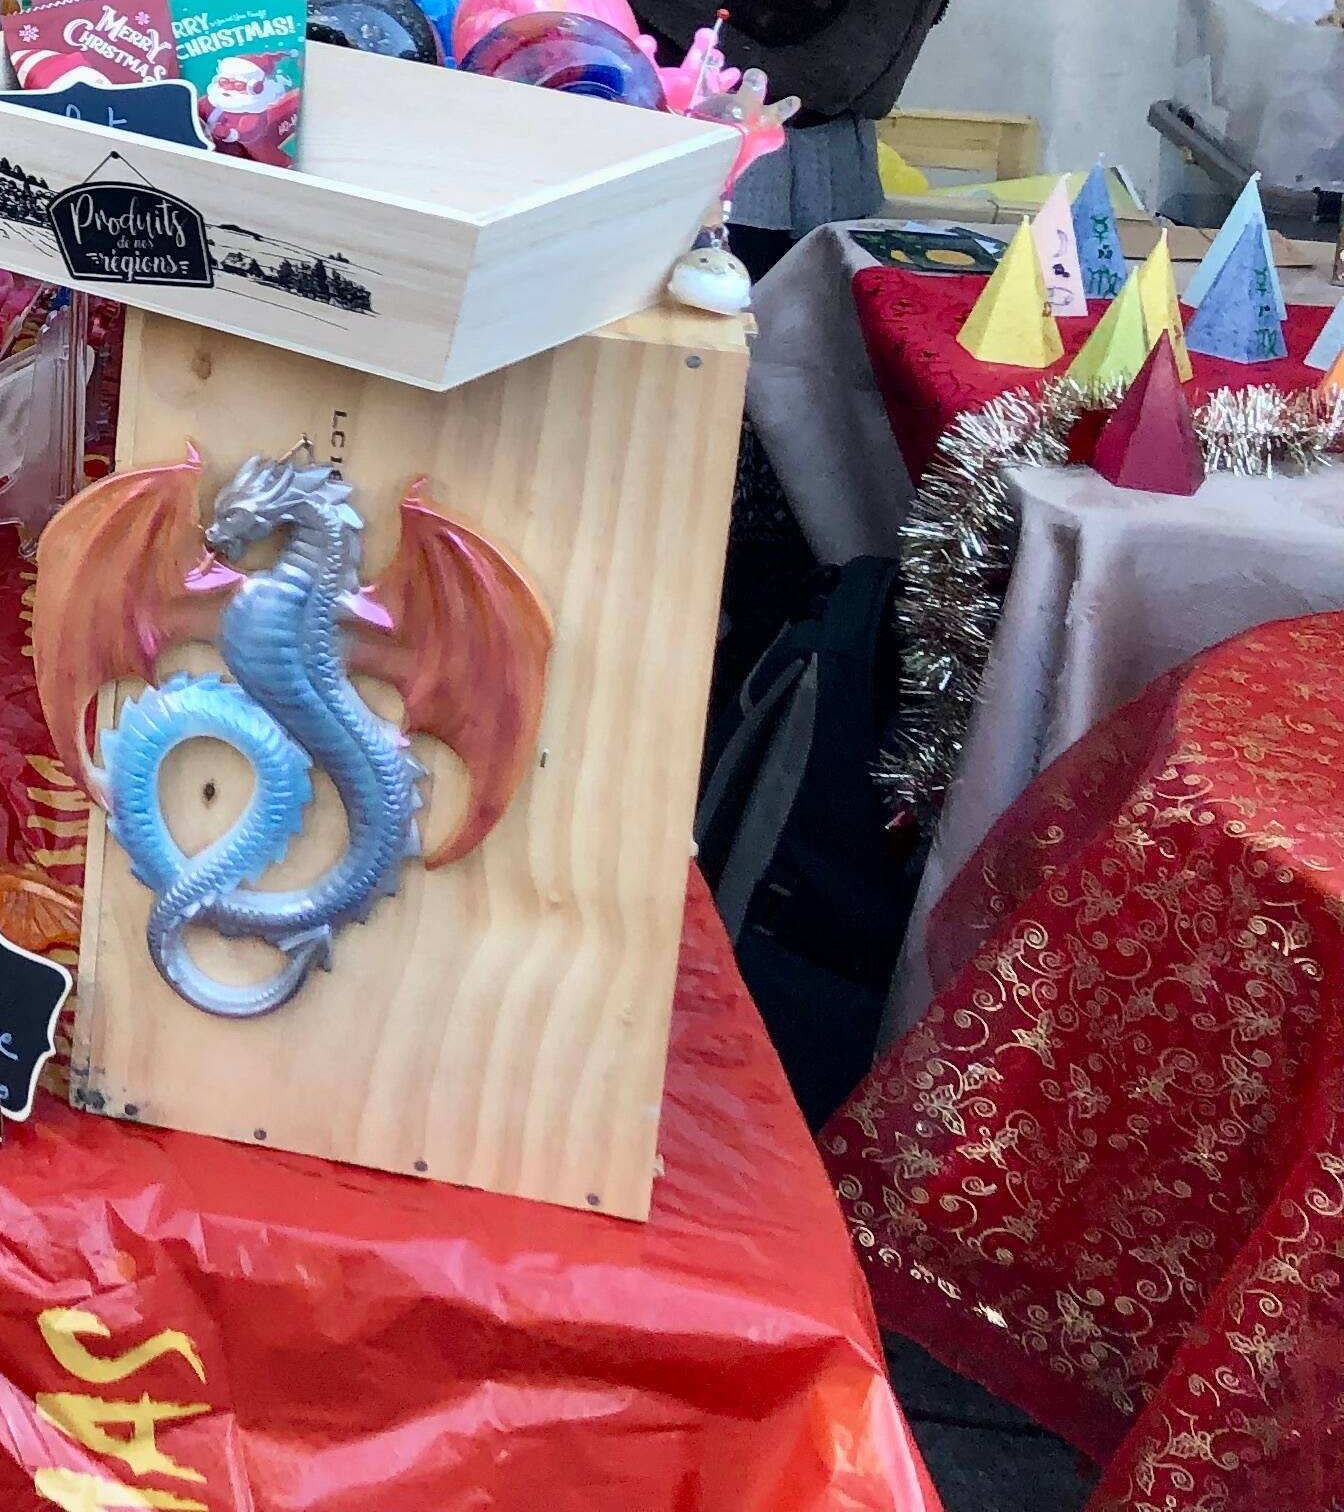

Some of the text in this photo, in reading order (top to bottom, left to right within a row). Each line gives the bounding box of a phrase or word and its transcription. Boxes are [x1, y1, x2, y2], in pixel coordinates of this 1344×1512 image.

[63, 18, 167, 83] CHRISTMAS
[95, 4, 173, 64] MERRY
[176, 15, 296, 60] CHRISTMAS!
[70, 193, 188, 248] Produits
[98, 249, 179, 282] régions
